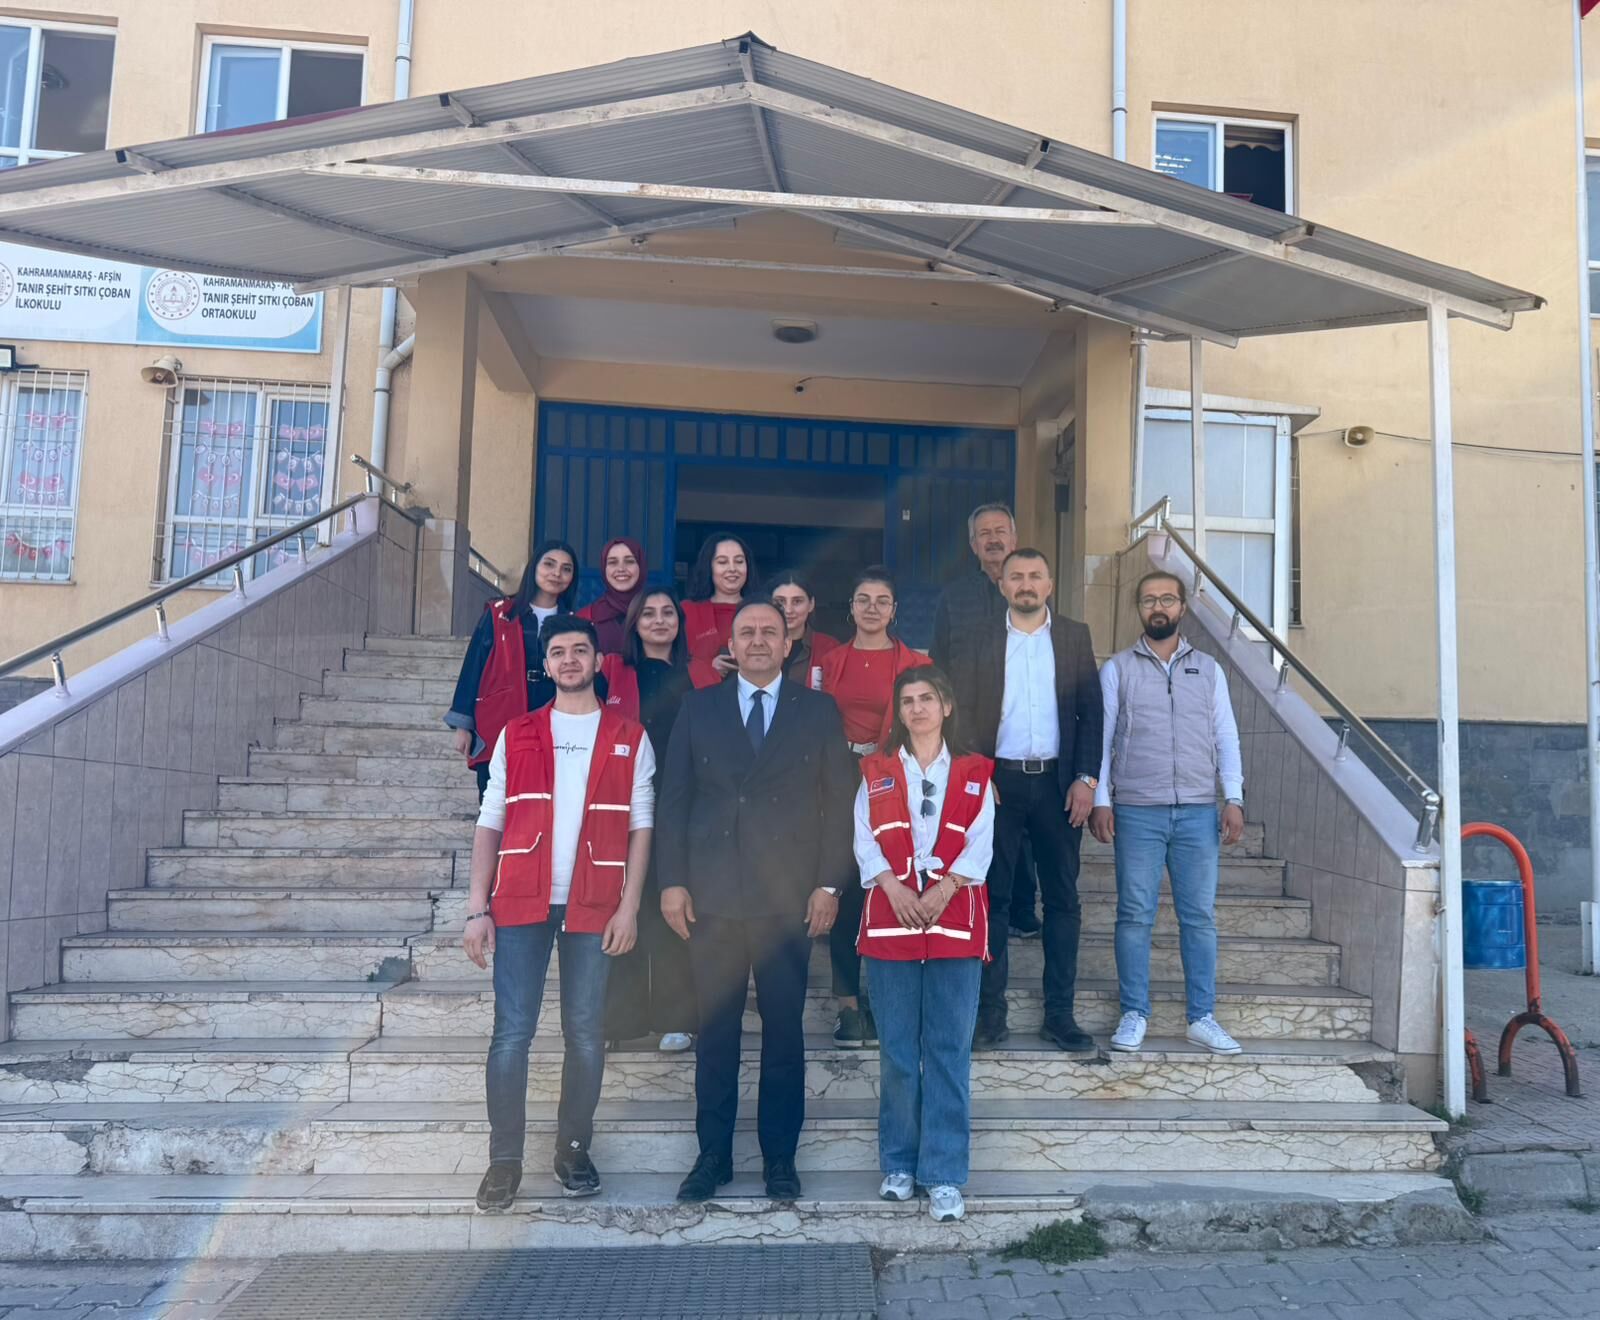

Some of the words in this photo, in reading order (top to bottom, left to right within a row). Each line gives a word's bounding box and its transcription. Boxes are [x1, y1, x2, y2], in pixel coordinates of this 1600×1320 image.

[17, 267, 92, 282] KAHRAMANMARAŞ
[98, 270, 121, 283] AFŞİN
[17, 282, 44, 294] TANIR
[45, 283, 72, 296] ŞEHİT
[73, 285, 97, 297] SITKI
[98, 287, 131, 300] ÇOBAN
[15, 295, 62, 310] İLKOKULU
[203, 292, 230, 304] TANIR
[231, 292, 257, 306] ŞEHİT
[258, 294, 281, 305] SITKI
[282, 296, 314, 309] ÇOBAN
[201, 307, 257, 320] ORTAOKULU
